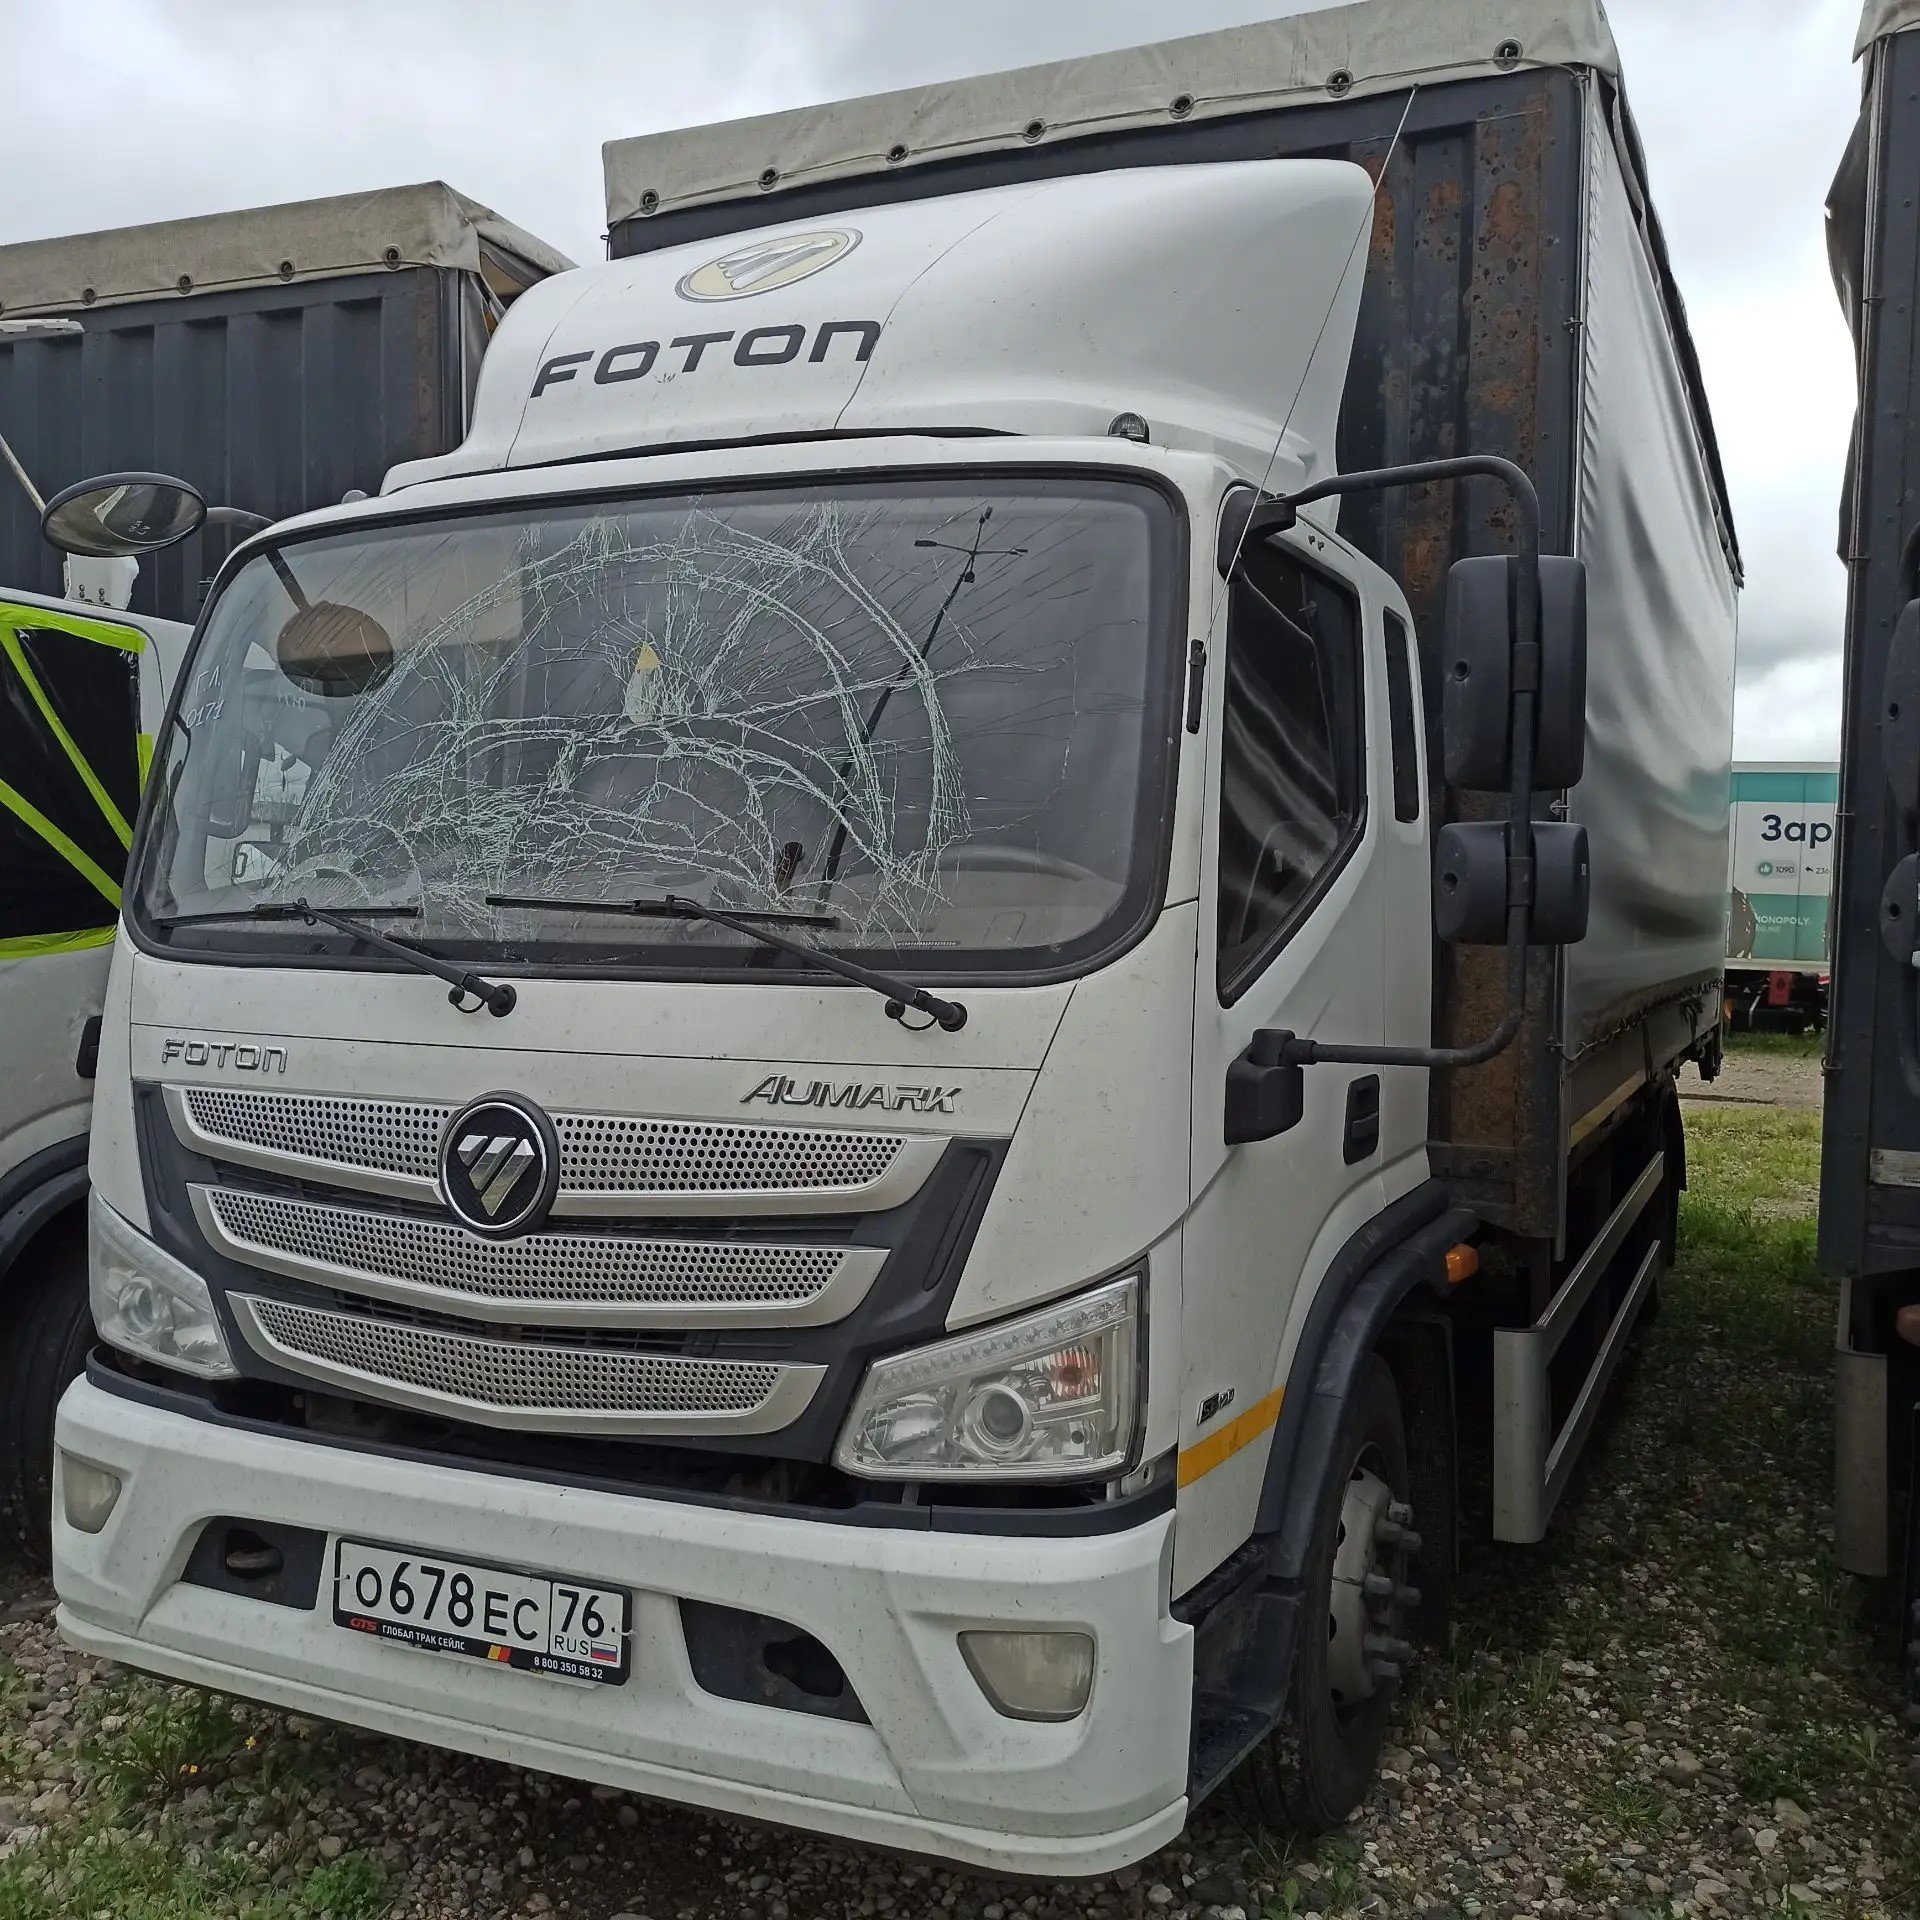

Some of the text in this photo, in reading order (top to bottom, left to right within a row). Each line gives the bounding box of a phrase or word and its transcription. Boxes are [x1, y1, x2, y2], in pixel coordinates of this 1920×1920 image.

[529, 320, 882, 399] FOTON
[185, 699, 225, 729] 0171
[1776, 865, 1796, 874] 1090
[161, 1038, 288, 1073] FOTON
[739, 1072, 963, 1113] AUMARK
[350, 1617, 377, 1631] GTS
[558, 1588, 605, 1639] 76
[381, 1624, 466, 1651] ГЛОБАЛ ТРАК СЕЙЛС
[554, 1634, 589, 1656] RUS
[534, 1656, 603, 1679] 8 800 350 58 32
